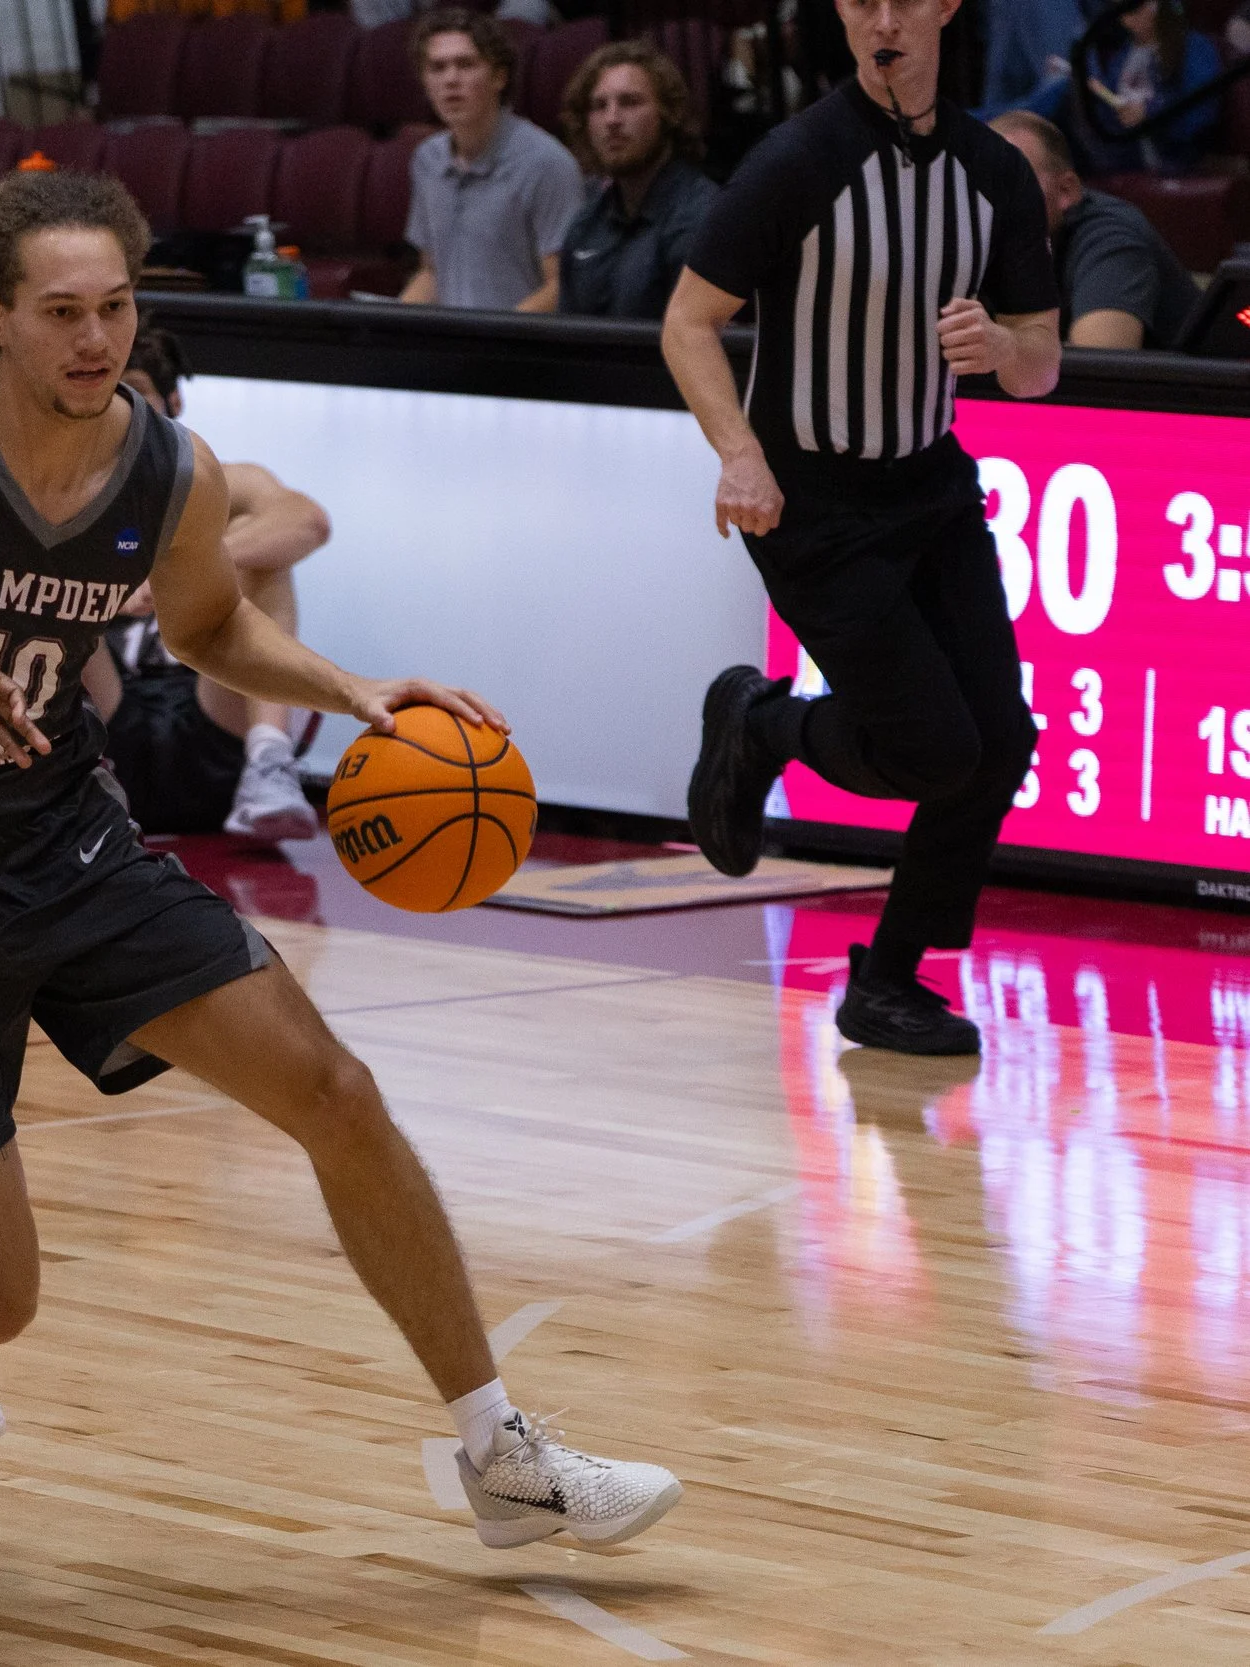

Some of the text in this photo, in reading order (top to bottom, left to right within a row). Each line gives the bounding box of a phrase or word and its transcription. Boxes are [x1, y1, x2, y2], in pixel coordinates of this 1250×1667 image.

[1163, 491, 1250, 602] 3:
[1069, 667, 1104, 737] 3
[334, 754, 369, 780] EV
[1066, 748, 1101, 818] 3
[333, 814, 403, 864] Wils
